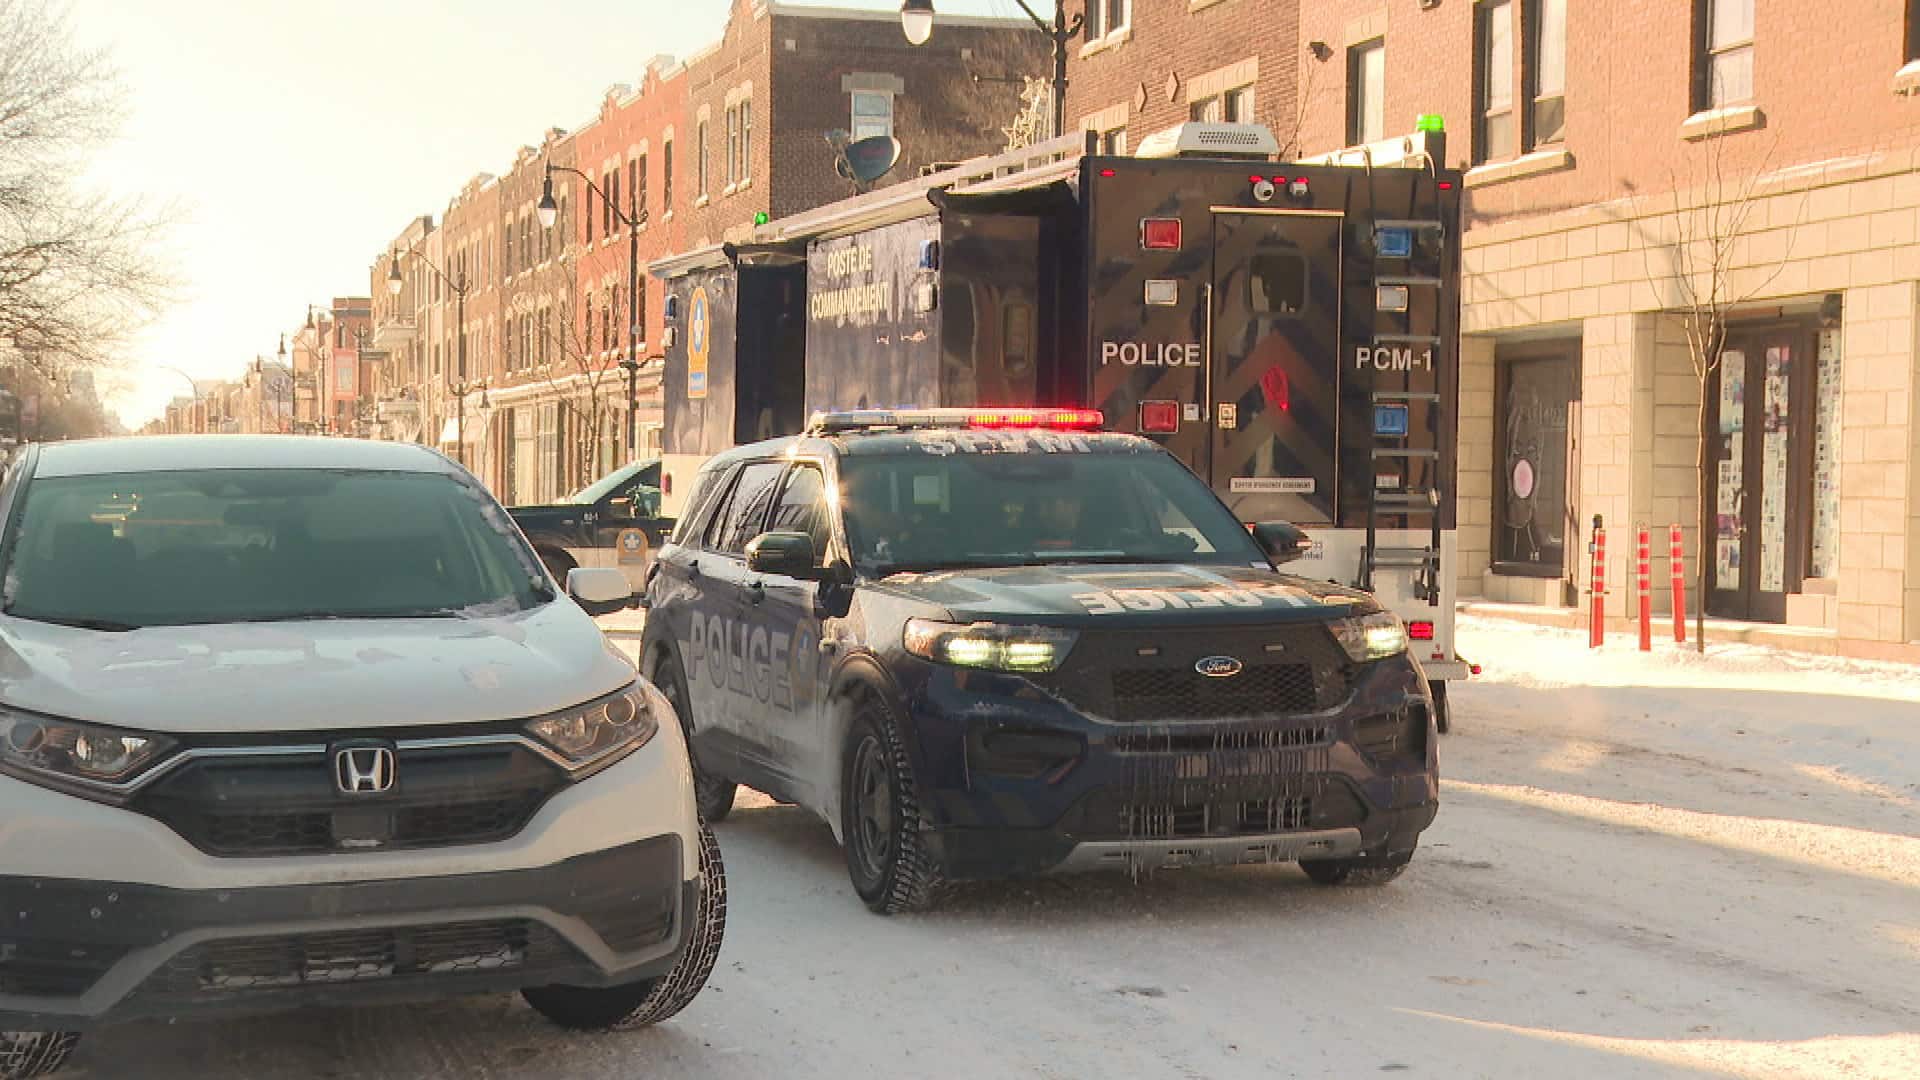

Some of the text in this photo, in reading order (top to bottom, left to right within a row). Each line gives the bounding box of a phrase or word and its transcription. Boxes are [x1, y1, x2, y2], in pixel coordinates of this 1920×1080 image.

[828, 246, 872, 279] POSTE DE
[811, 282, 889, 320] COMMANDEMENT
[1102, 341, 1201, 366] POLICE
[1356, 347, 1432, 371] PCM-1
[688, 610, 792, 712] POLICE
